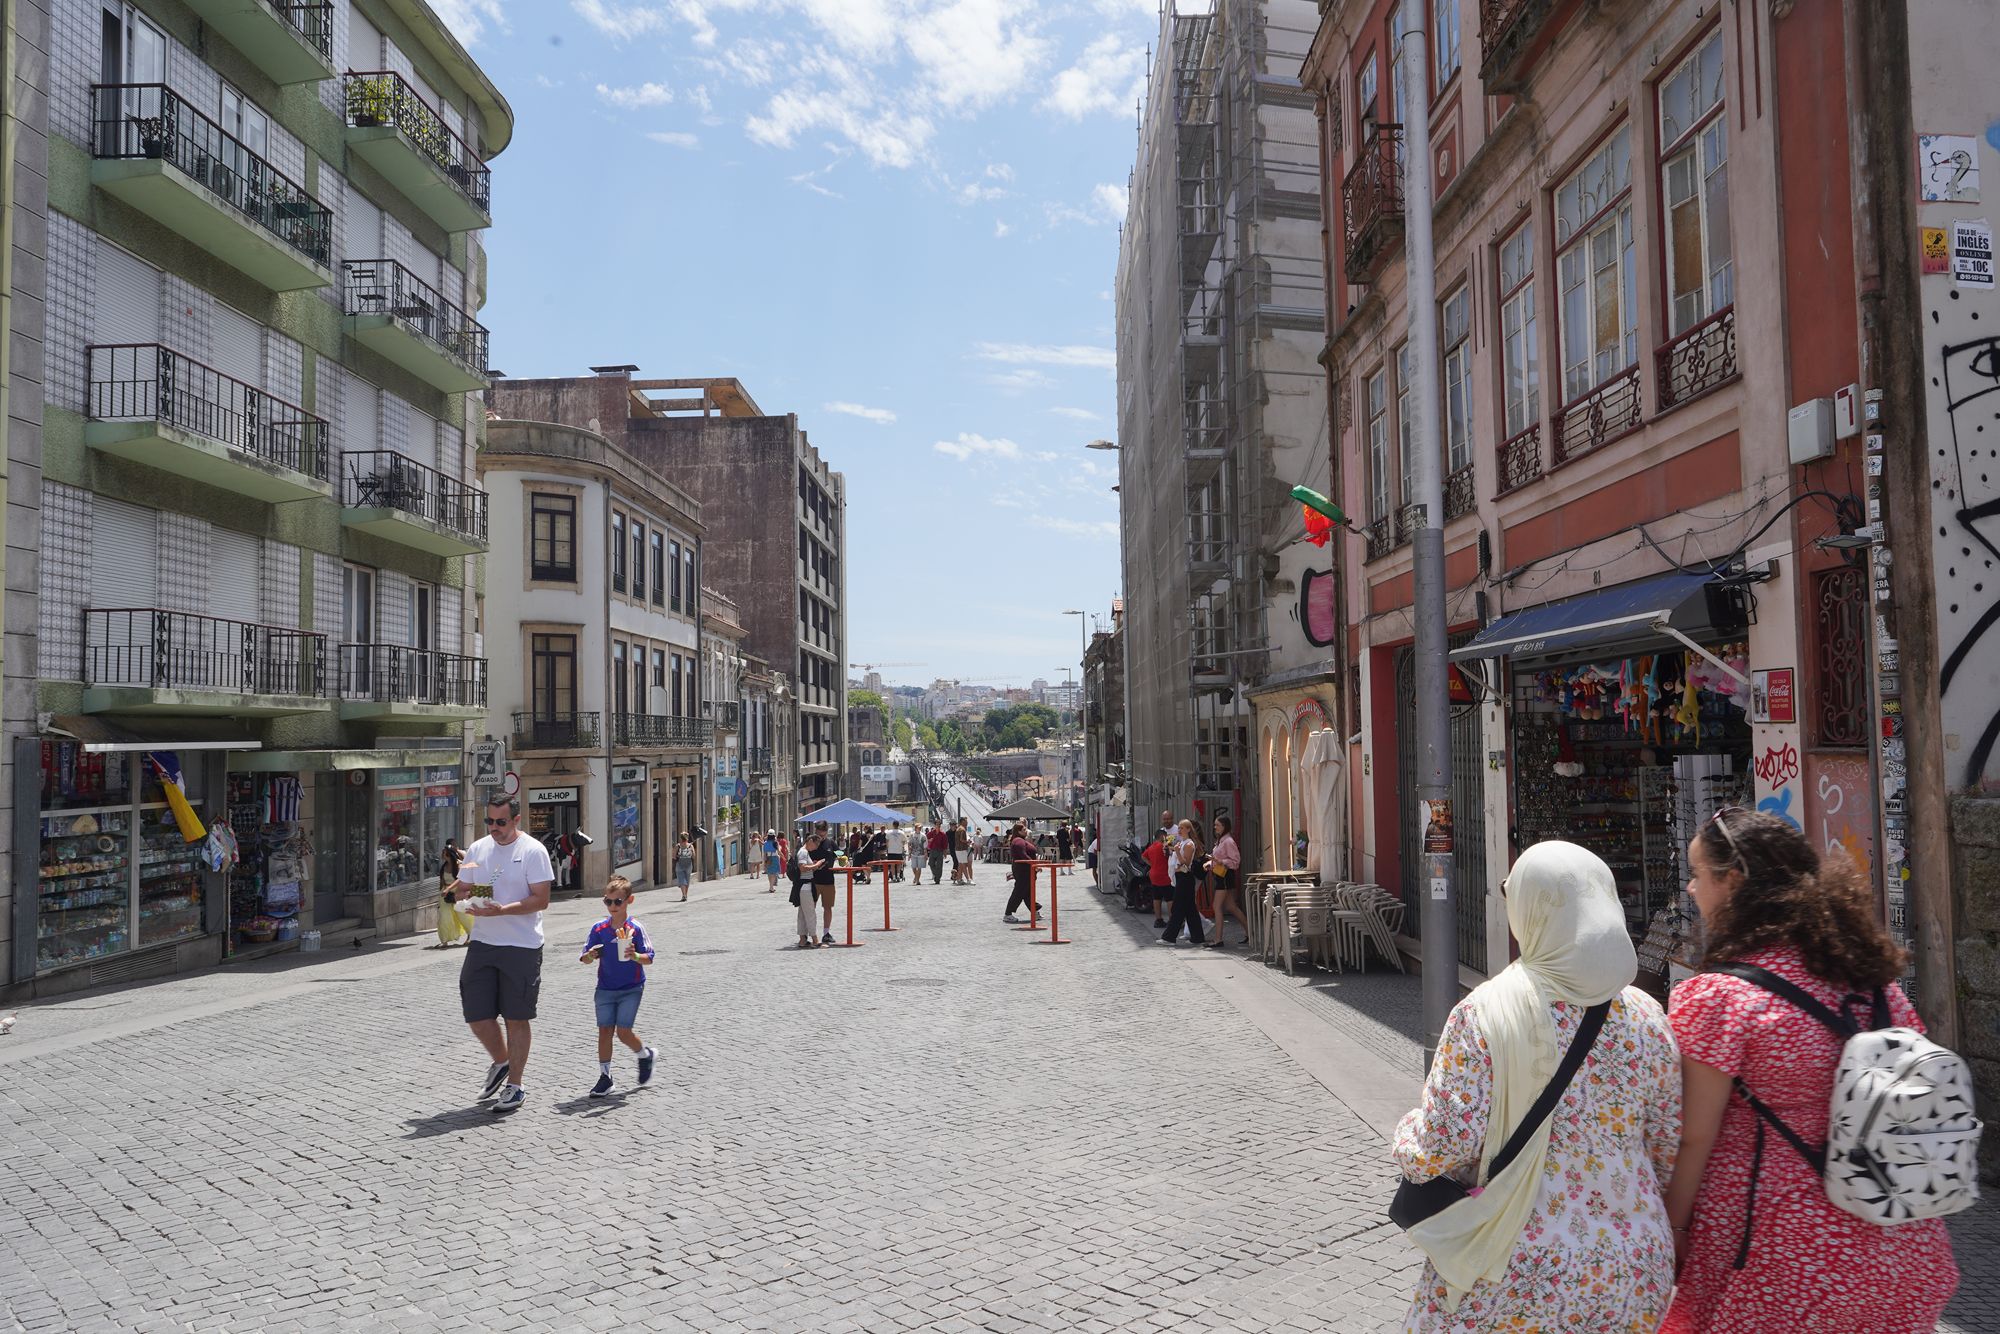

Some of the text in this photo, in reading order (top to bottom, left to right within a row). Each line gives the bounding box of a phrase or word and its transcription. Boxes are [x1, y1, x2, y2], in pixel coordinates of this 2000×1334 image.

[1957, 235, 1989, 250] INGLÊS
[1960, 250, 1987, 258] ONLINE
[1593, 569, 1601, 585] 81
[538, 791, 570, 801] ALE-HOP
